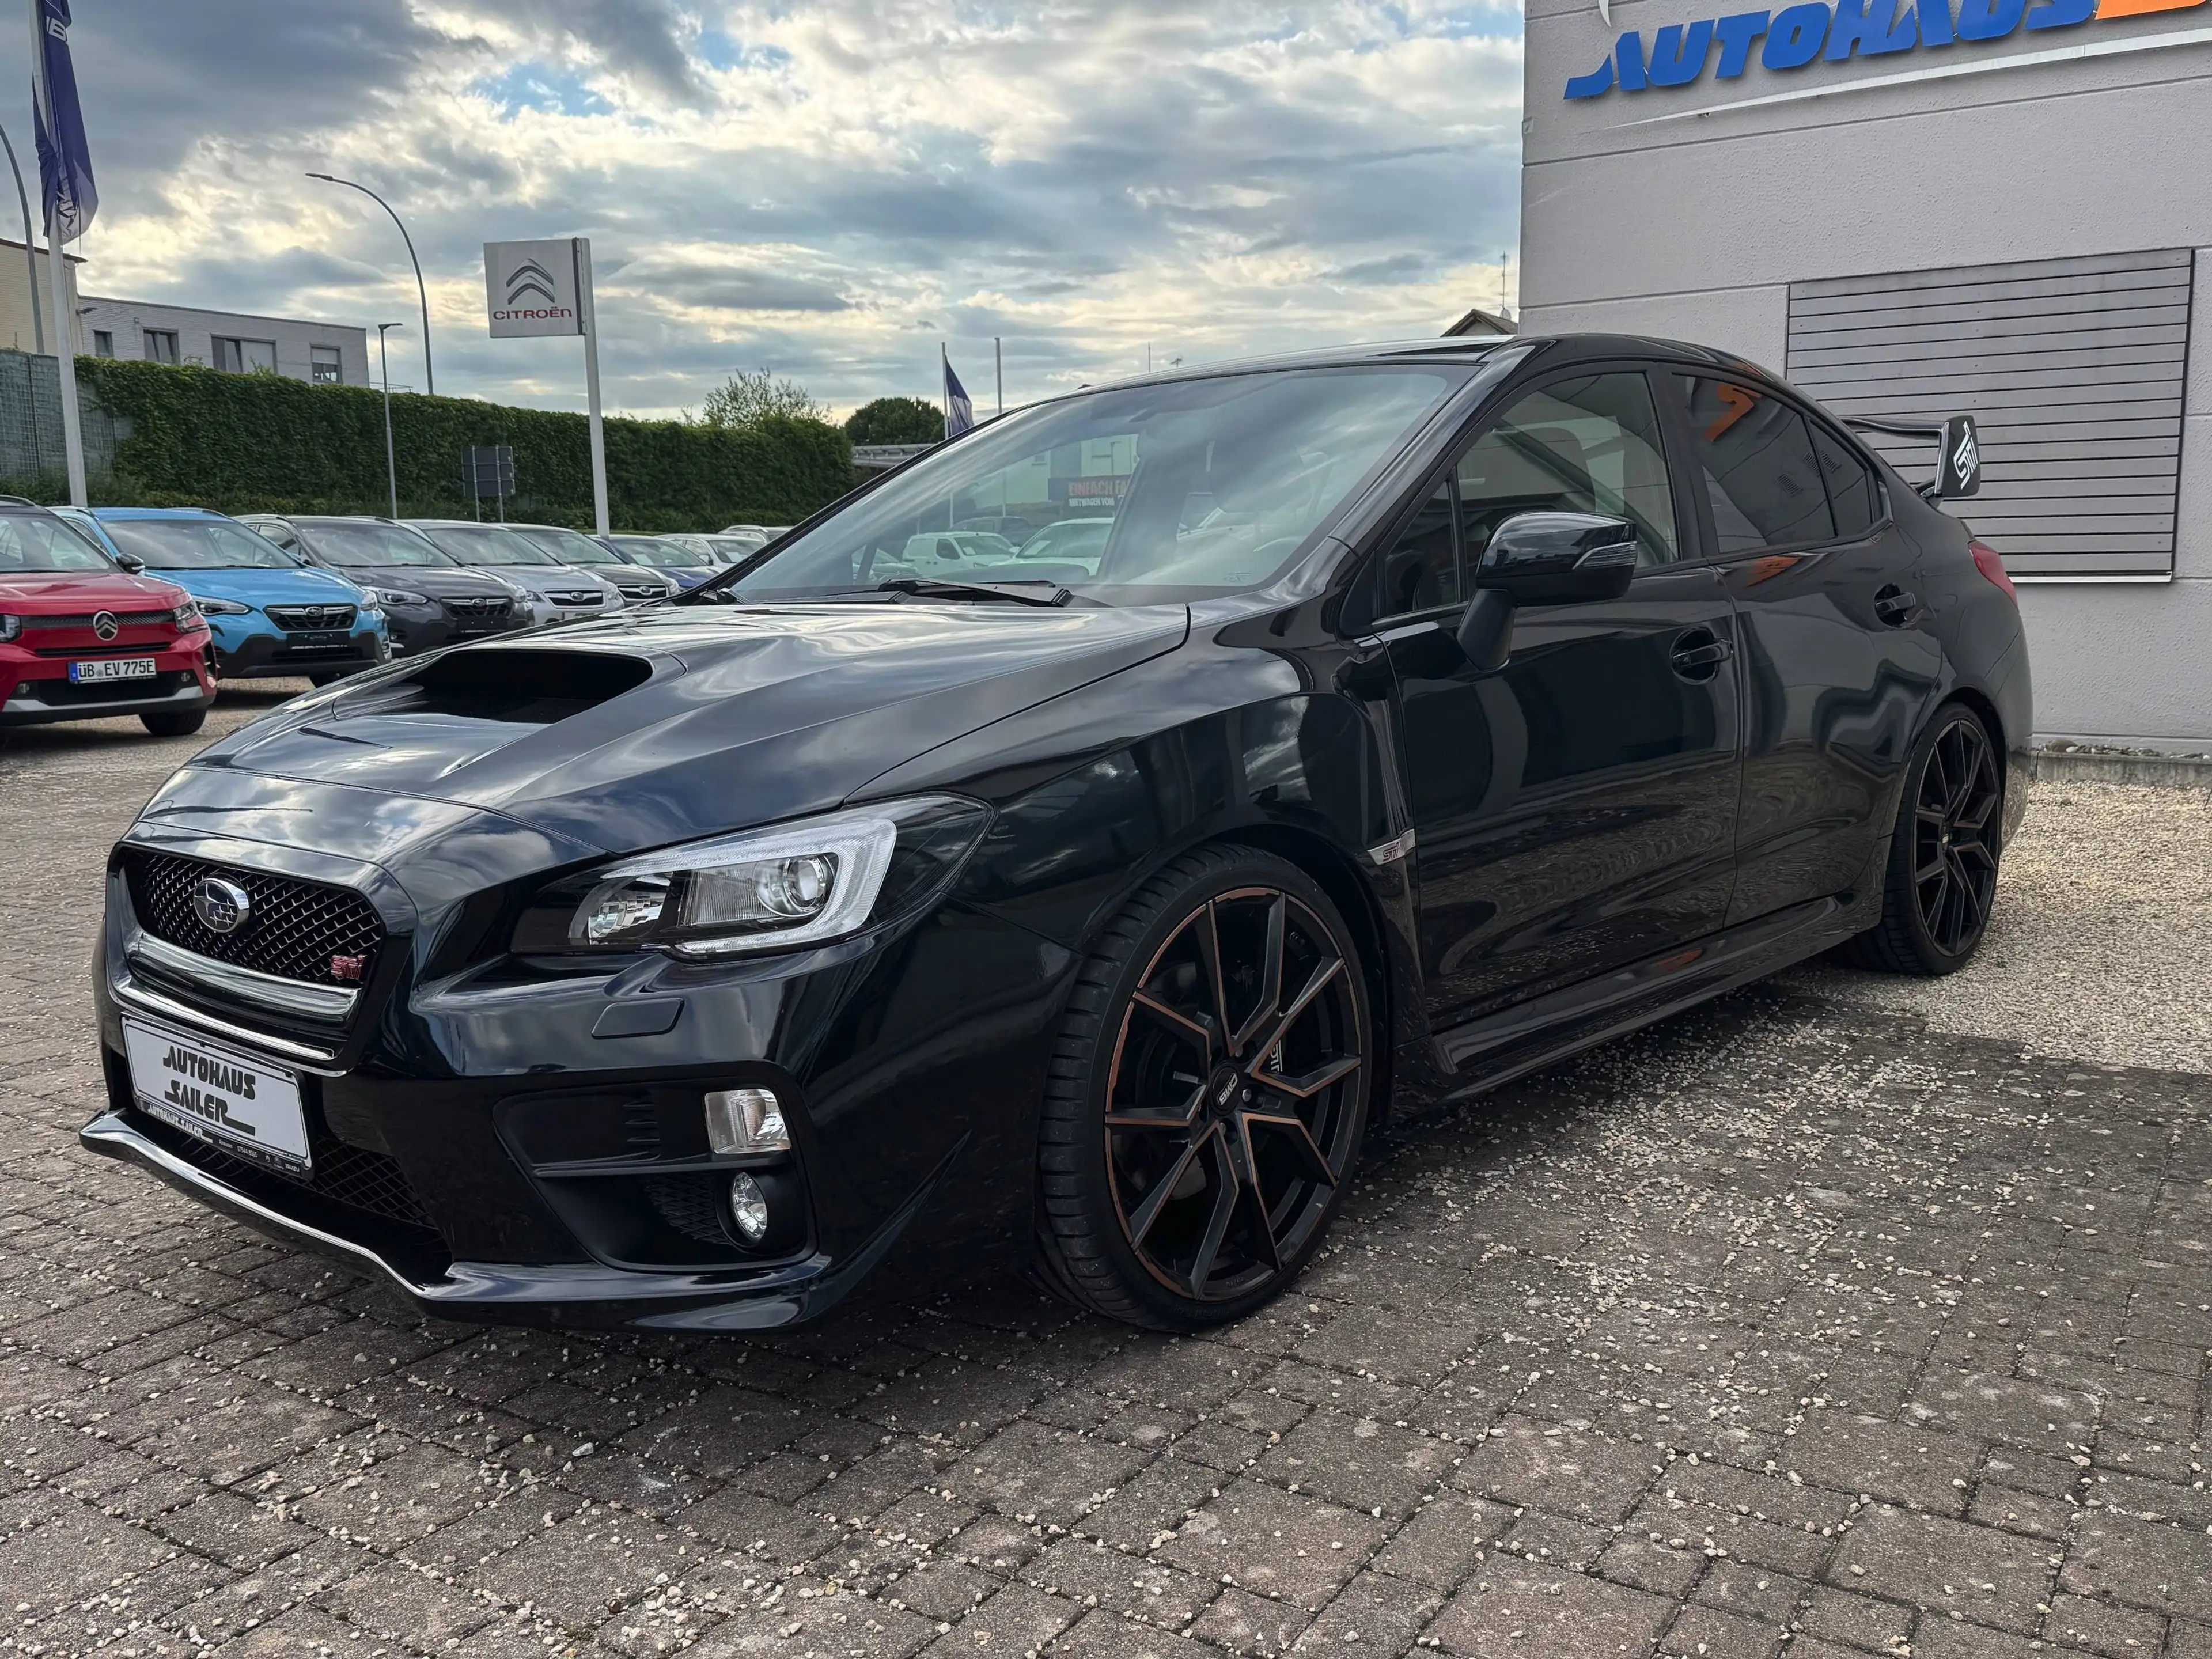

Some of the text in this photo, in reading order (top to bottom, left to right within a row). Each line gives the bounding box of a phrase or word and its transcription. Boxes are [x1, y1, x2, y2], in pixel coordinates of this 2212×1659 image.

[104, 662, 120, 676] EV
[123, 660, 154, 675] 775E
[162, 1045, 256, 1100] AUTOHAUS
[147, 1104, 179, 1127] AUTOHAUS
[176, 1118, 213, 1143] SAILER
[164, 1079, 256, 1136] SAILER
